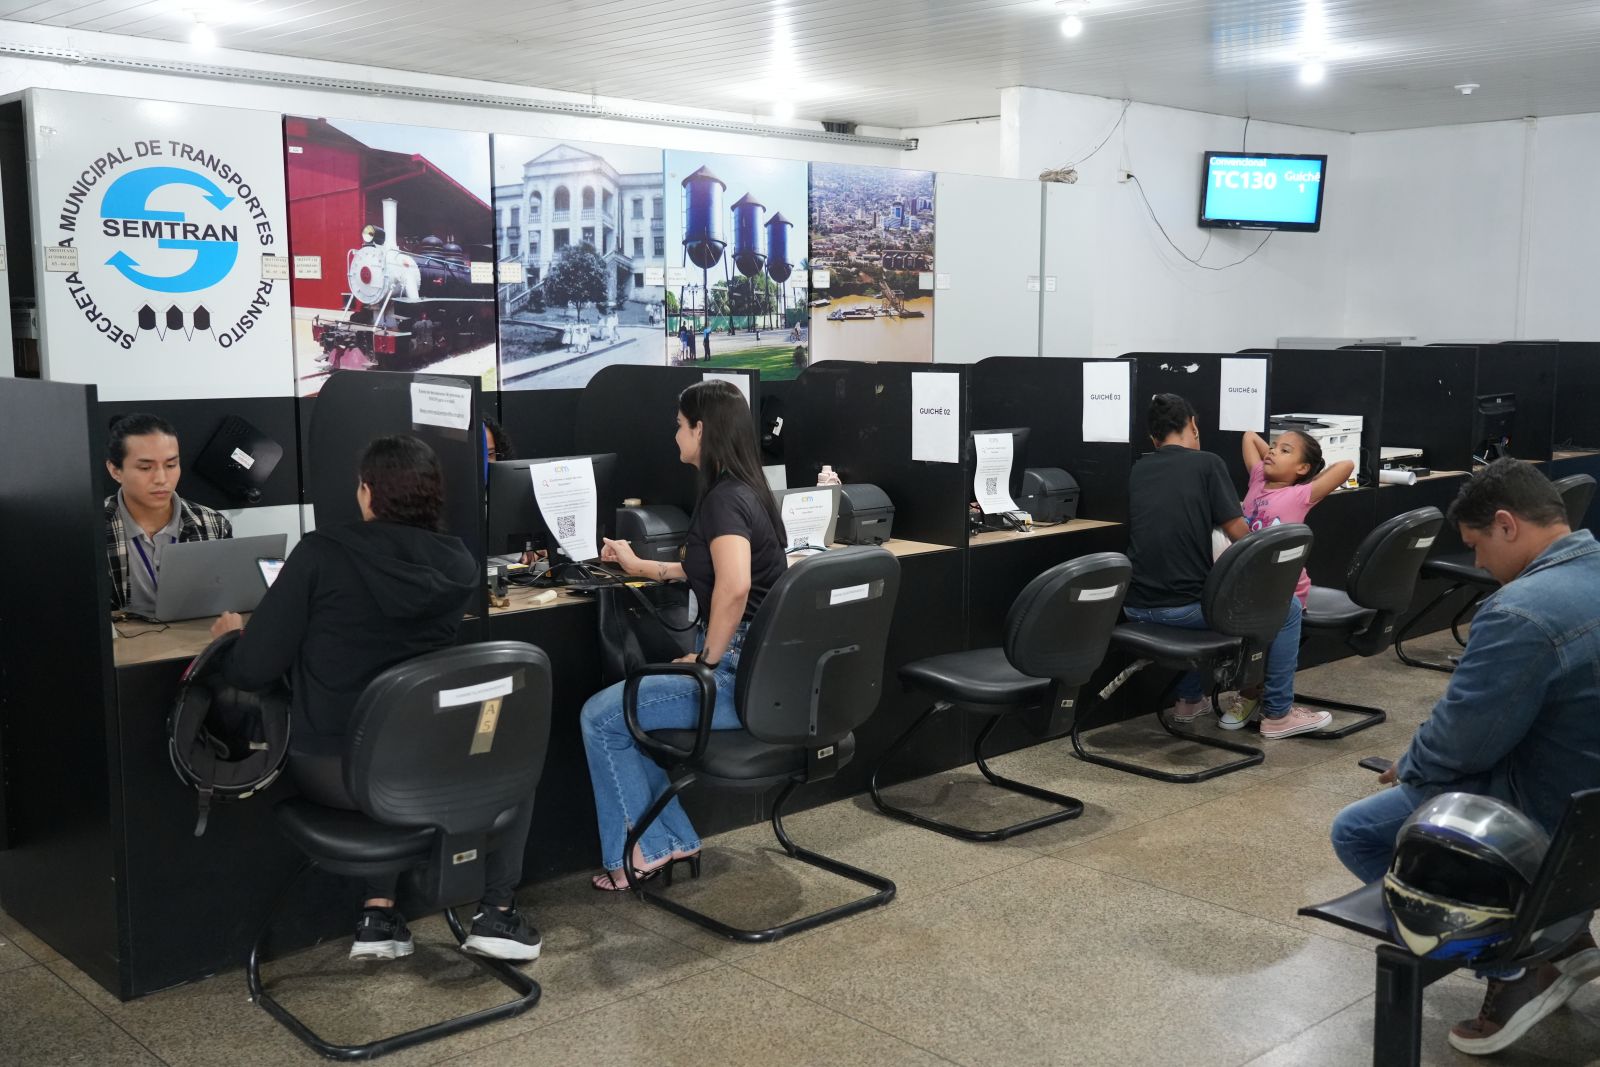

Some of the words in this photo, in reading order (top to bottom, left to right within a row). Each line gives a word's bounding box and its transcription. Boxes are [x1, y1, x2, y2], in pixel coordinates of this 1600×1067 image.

[135, 139, 163, 158] DE
[1209, 156, 1267, 168] Convencional
[1212, 170, 1278, 190] TC130
[1284, 170, 1321, 182] Guichê
[59, 147, 133, 232] MUNICIPAL
[168, 140, 275, 247] TRANSPORTES
[1298, 183, 1305, 193] 1
[102, 218, 238, 242] SEMTRAN
[218, 279, 274, 349] RÂNSITO
[944, 408, 951, 416] 02
[485, 703, 496, 715] A
